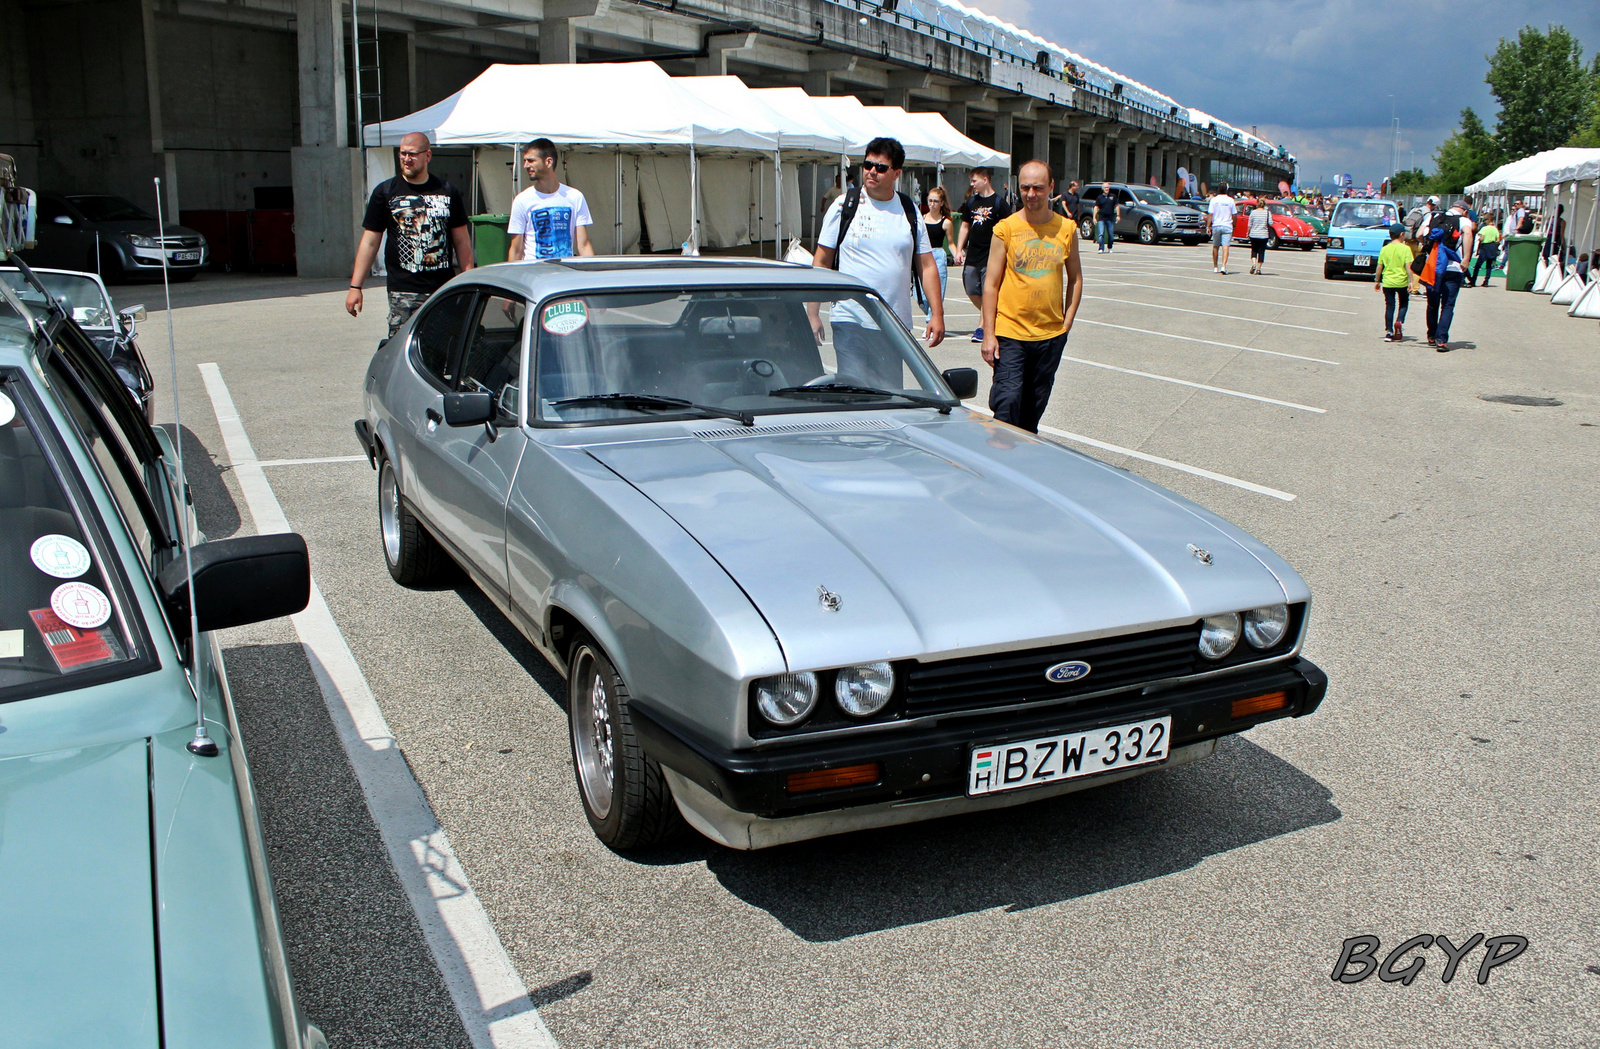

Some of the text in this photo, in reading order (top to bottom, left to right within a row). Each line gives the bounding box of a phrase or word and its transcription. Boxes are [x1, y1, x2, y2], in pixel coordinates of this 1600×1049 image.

[548, 302, 584, 318] CLUB II.
[1056, 666, 1080, 678] Ford
[1004, 722, 1165, 784] BZW-332
